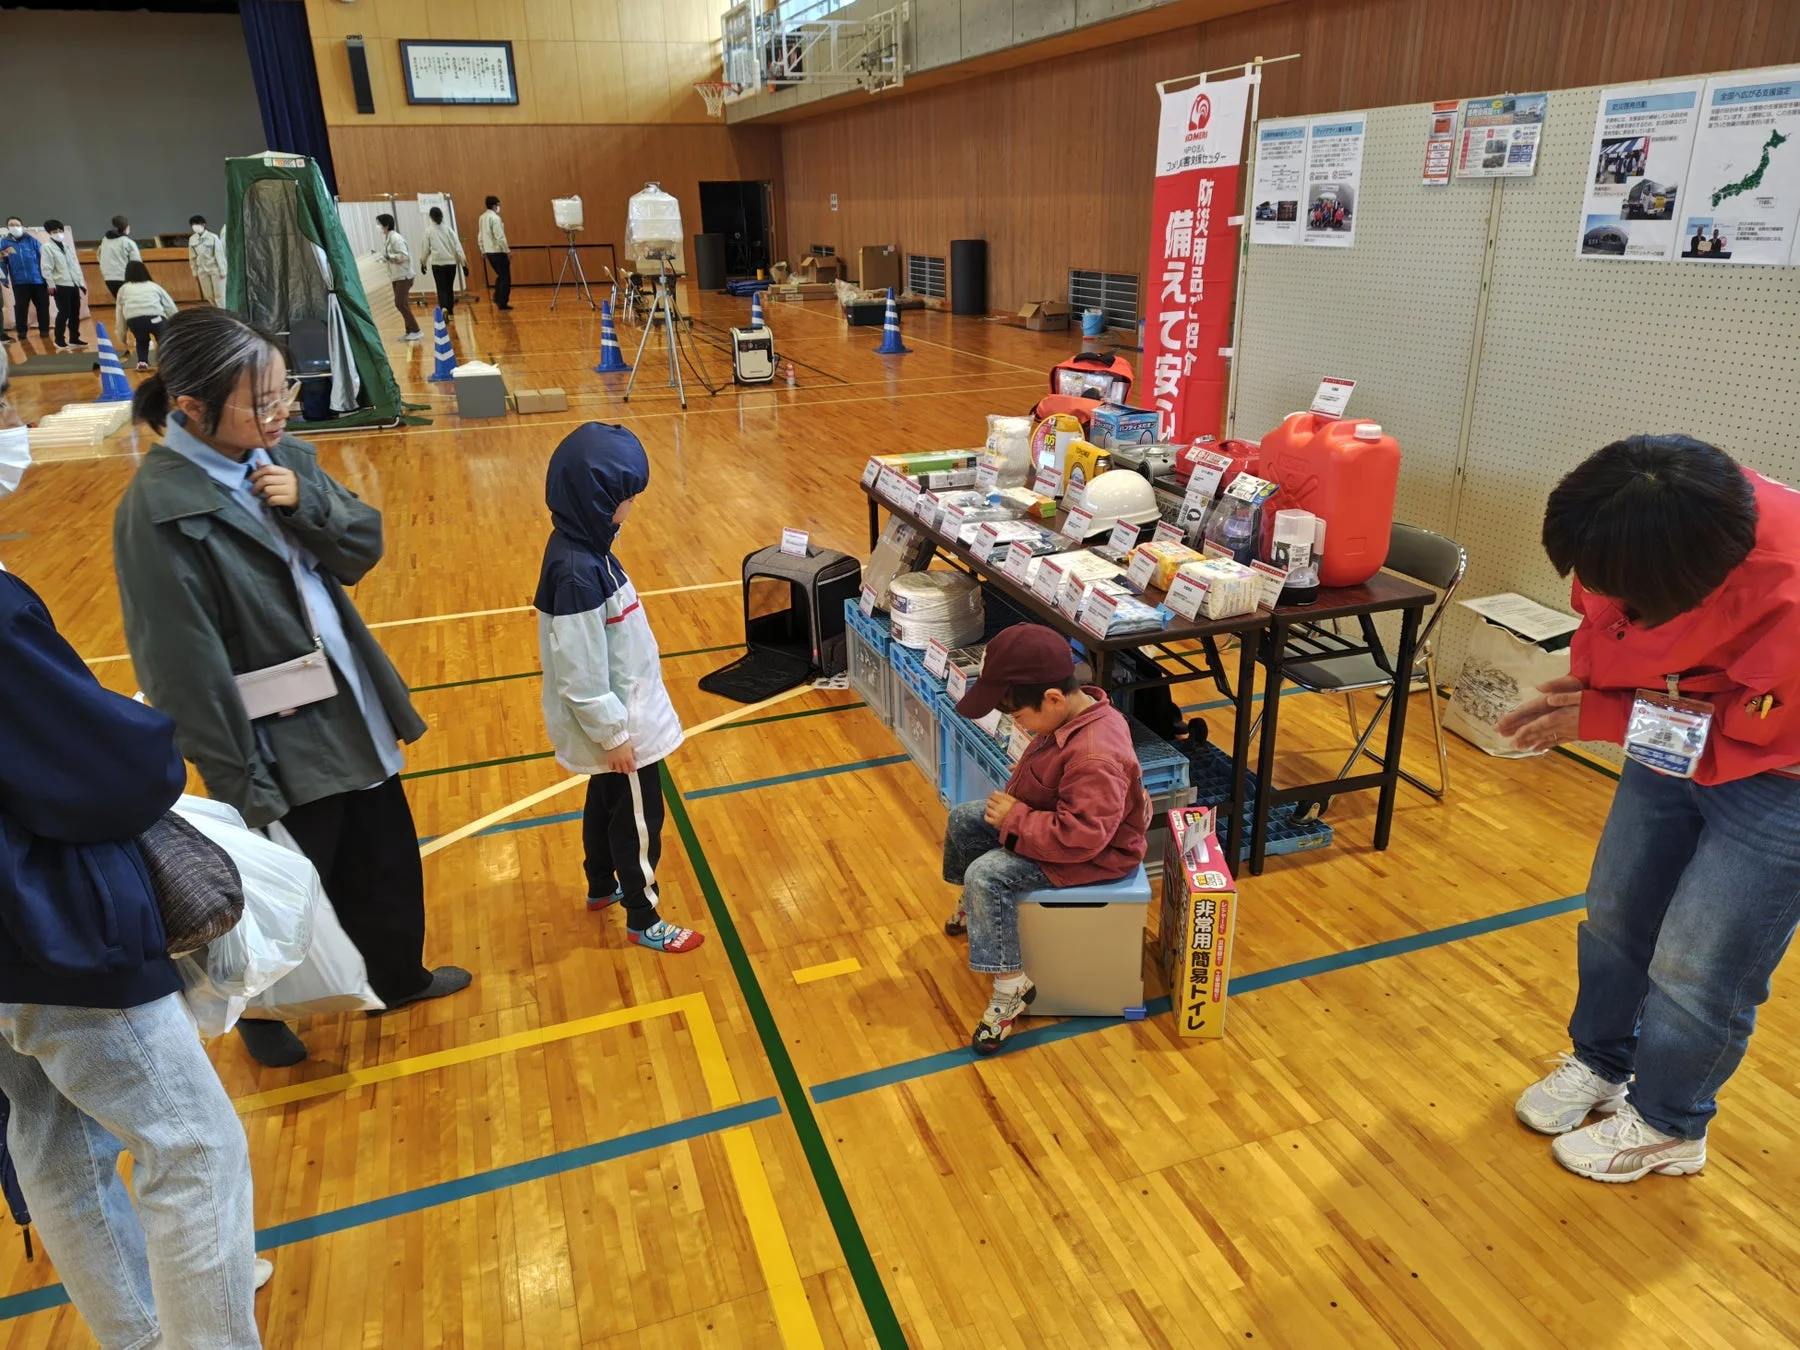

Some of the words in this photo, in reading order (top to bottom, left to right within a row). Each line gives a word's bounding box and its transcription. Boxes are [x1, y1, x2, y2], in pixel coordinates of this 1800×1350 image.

[1187, 899, 1216, 1031] 非常用簡易トイレ
